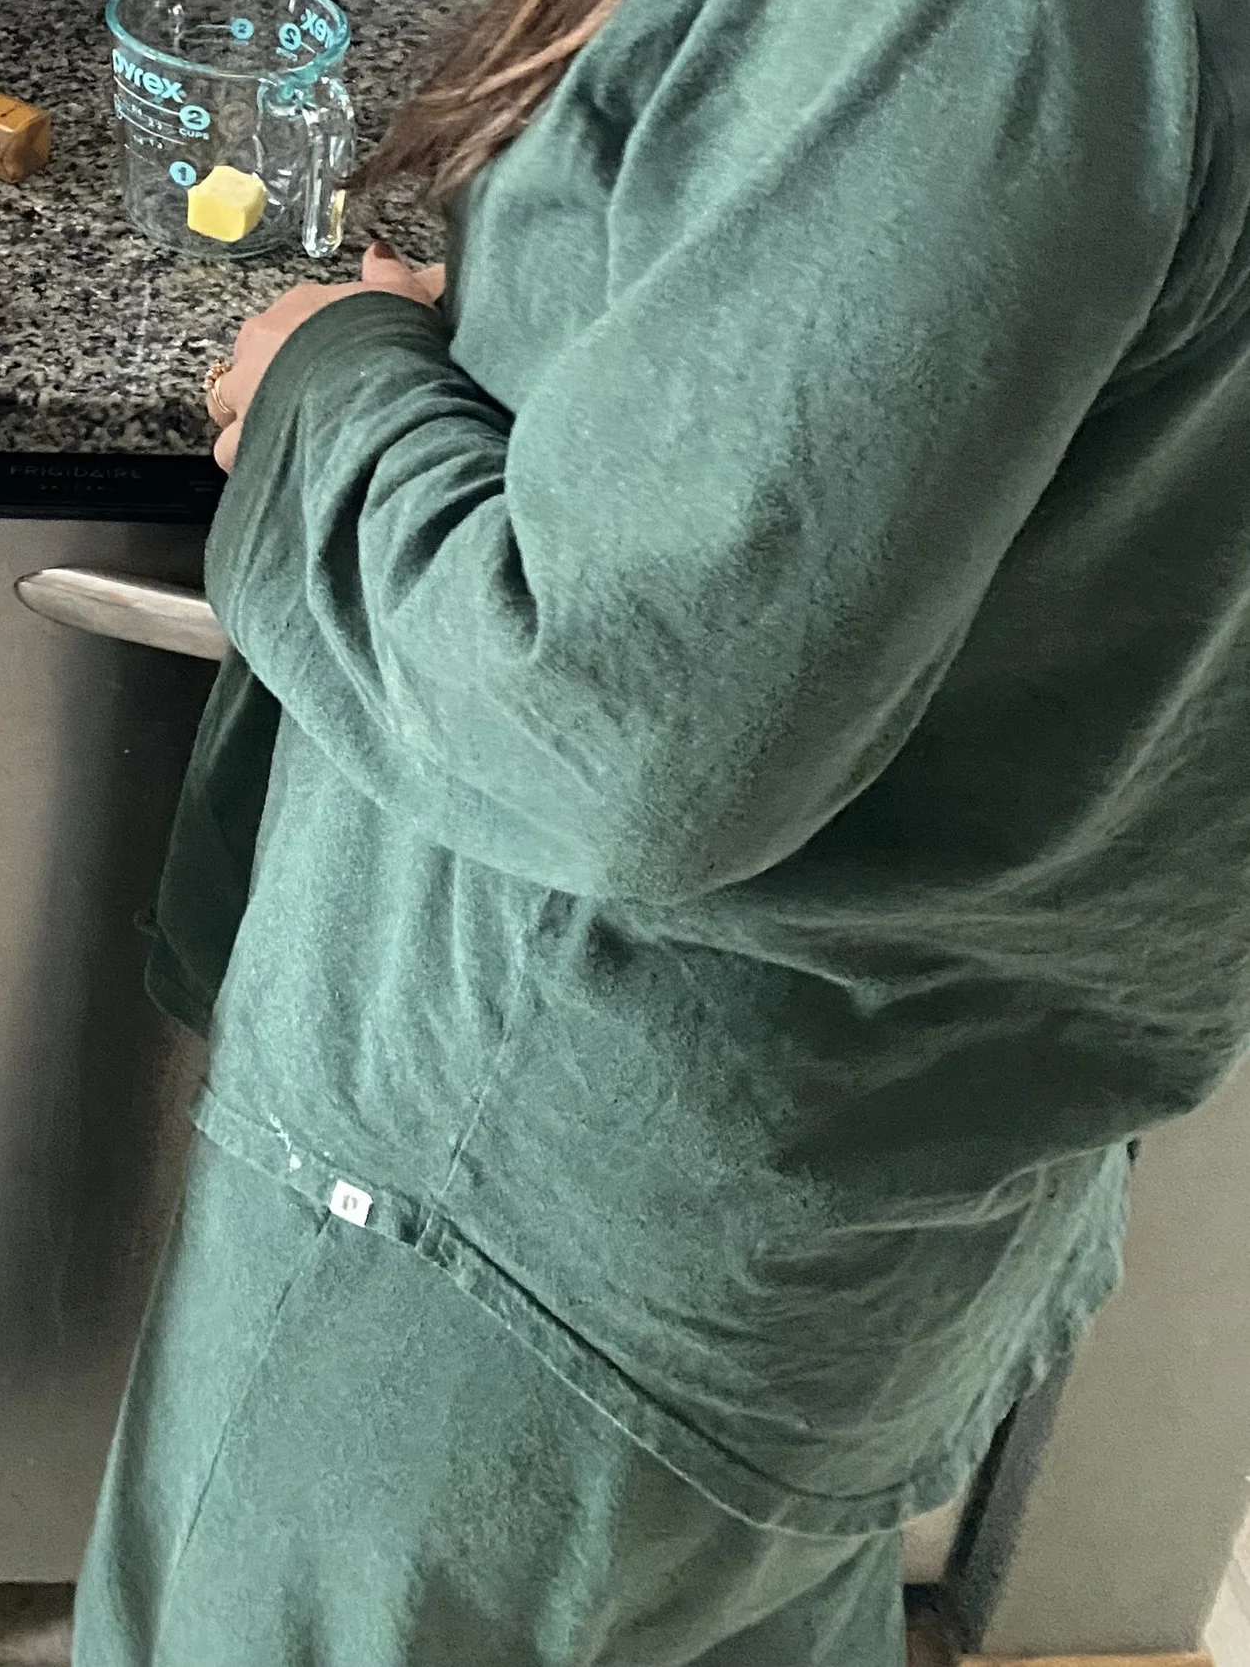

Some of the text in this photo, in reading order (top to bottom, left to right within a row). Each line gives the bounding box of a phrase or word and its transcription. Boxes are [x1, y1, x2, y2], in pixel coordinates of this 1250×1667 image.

[187, 109, 202, 126] 2
[178, 166, 187, 182] 1
[9, 465, 143, 479] FRIGIDAIRE
